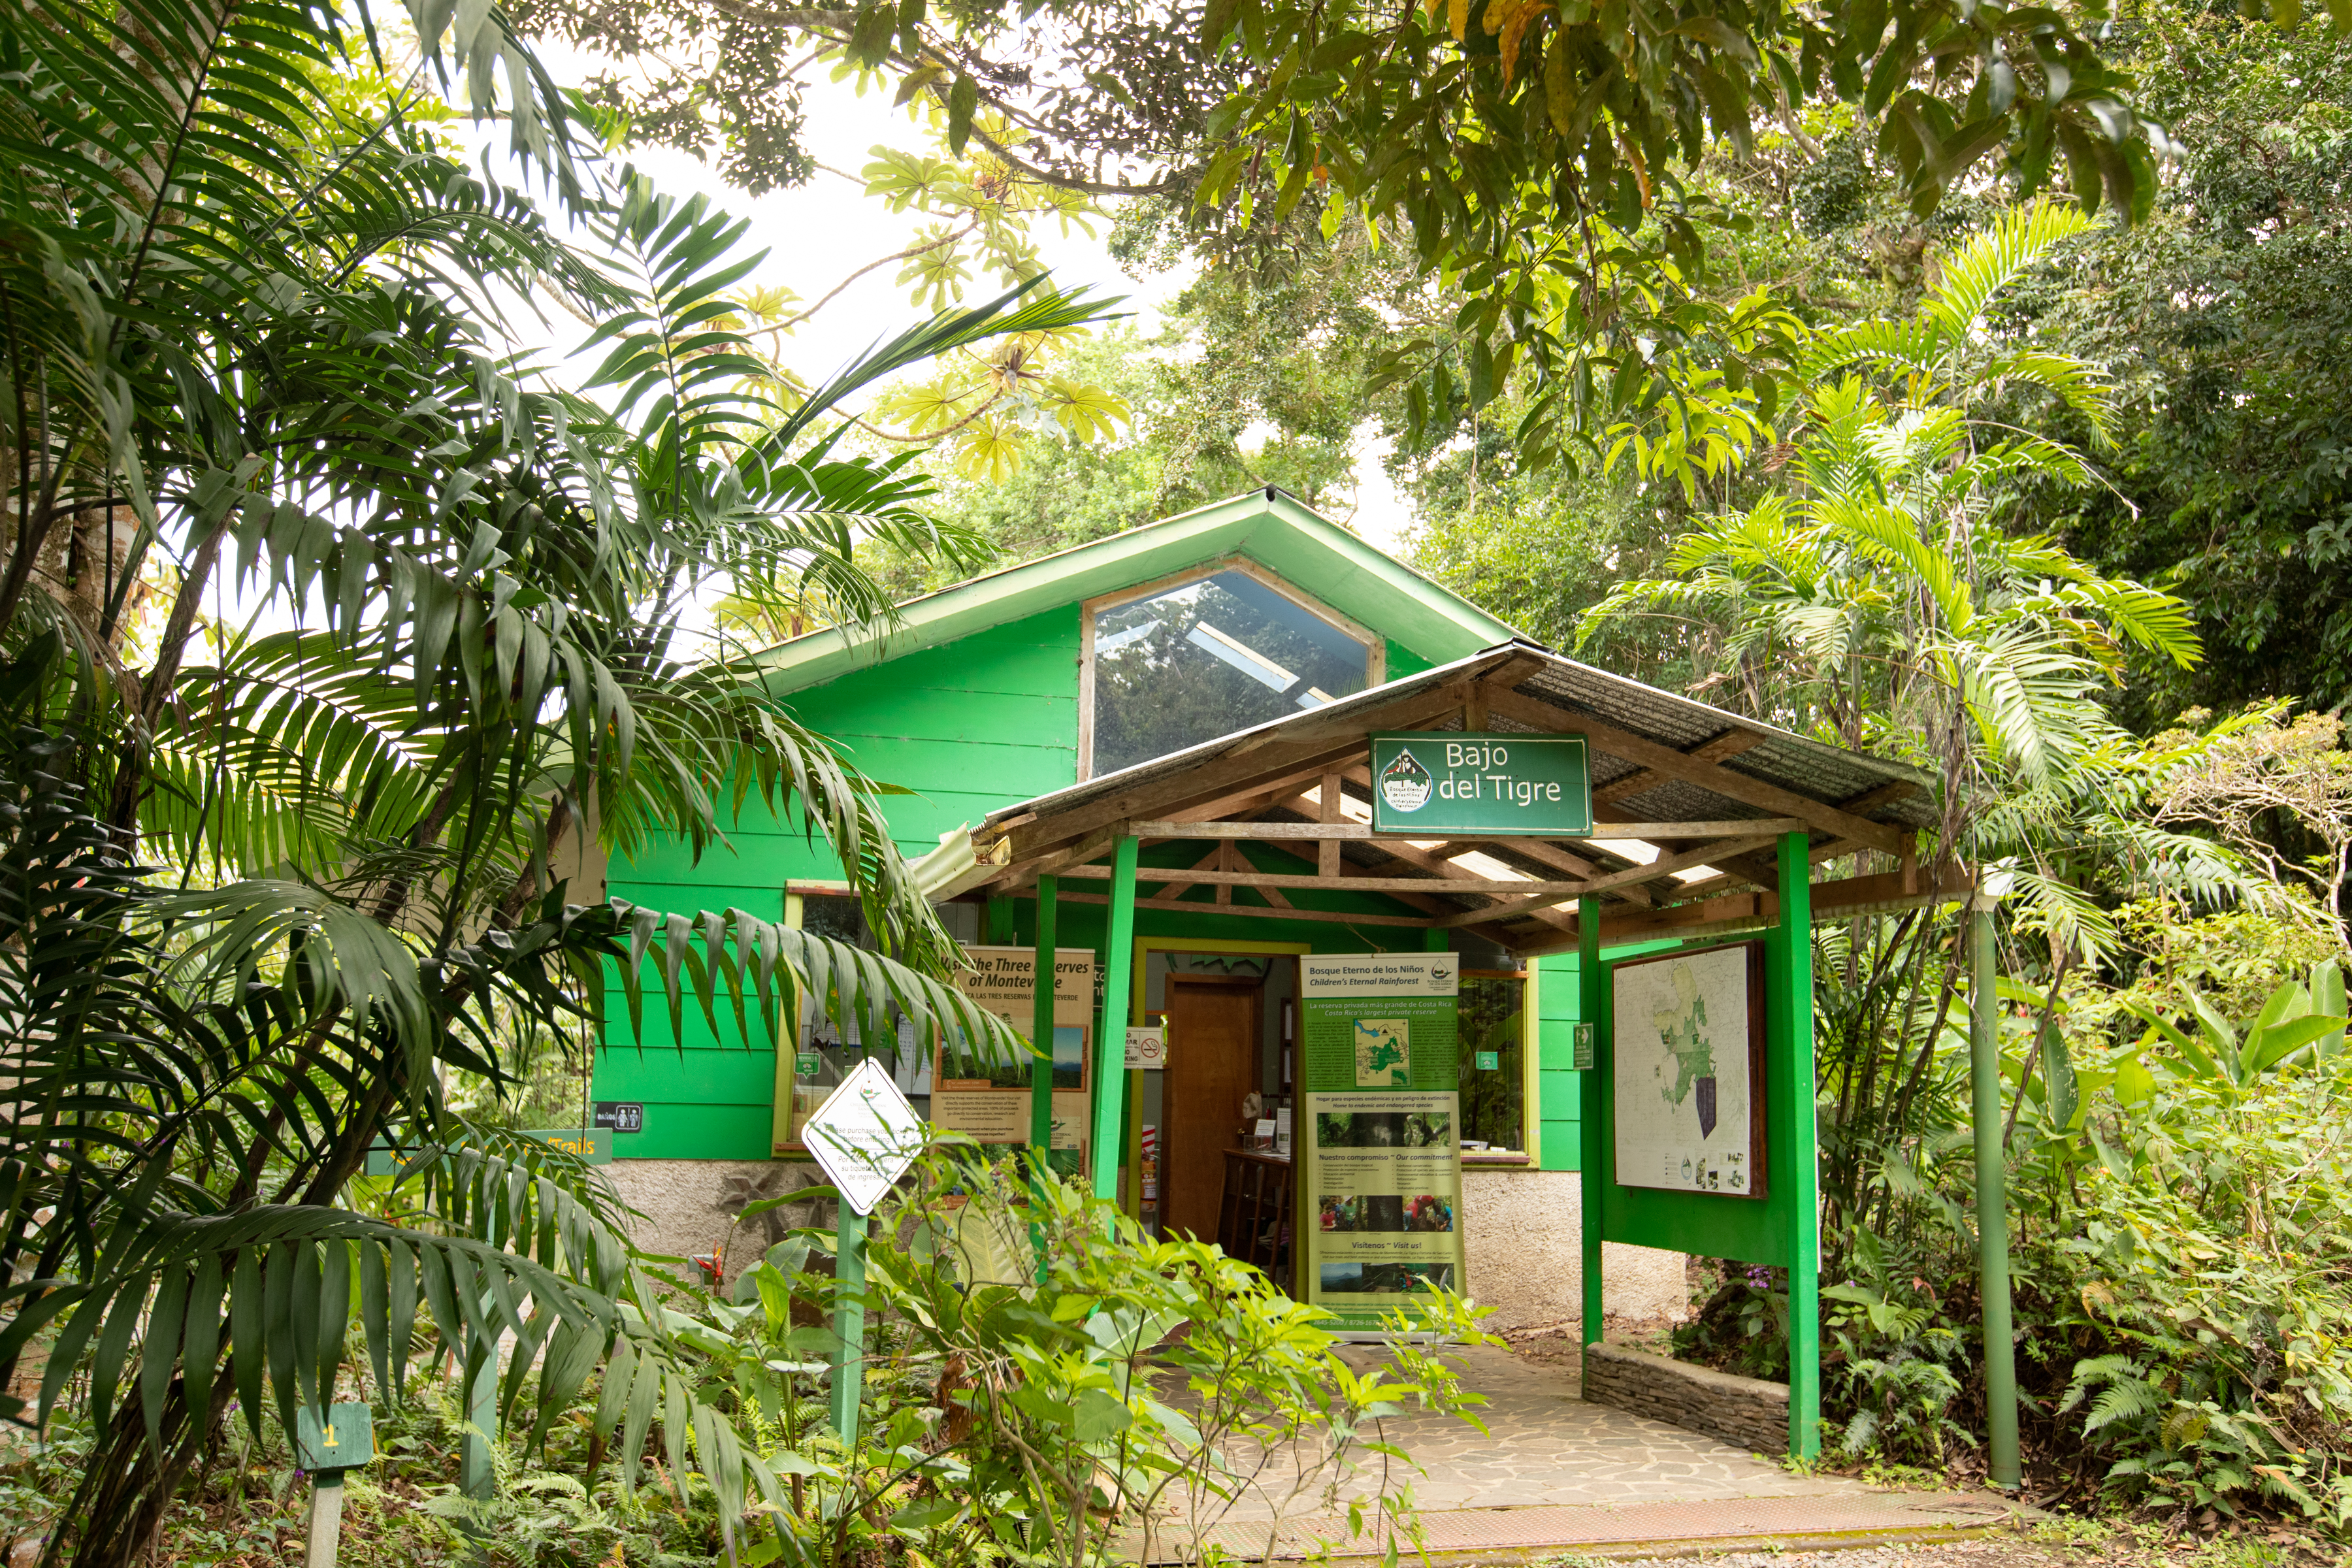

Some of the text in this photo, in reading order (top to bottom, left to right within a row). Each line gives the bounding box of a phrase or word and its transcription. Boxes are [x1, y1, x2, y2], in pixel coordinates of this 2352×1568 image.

[1446, 742, 1509, 772] Bajo
[1439, 771, 1561, 807] del Tigre
[971, 957, 992, 971] the
[996, 958, 1032, 972] Three
[1310, 967, 1340, 976] Bosque
[970, 973, 1062, 989] of Monteve
[1349, 977, 1377, 986] Eternal
[1379, 977, 1419, 986] Rainforest
[322, 1424, 339, 1447] 1
